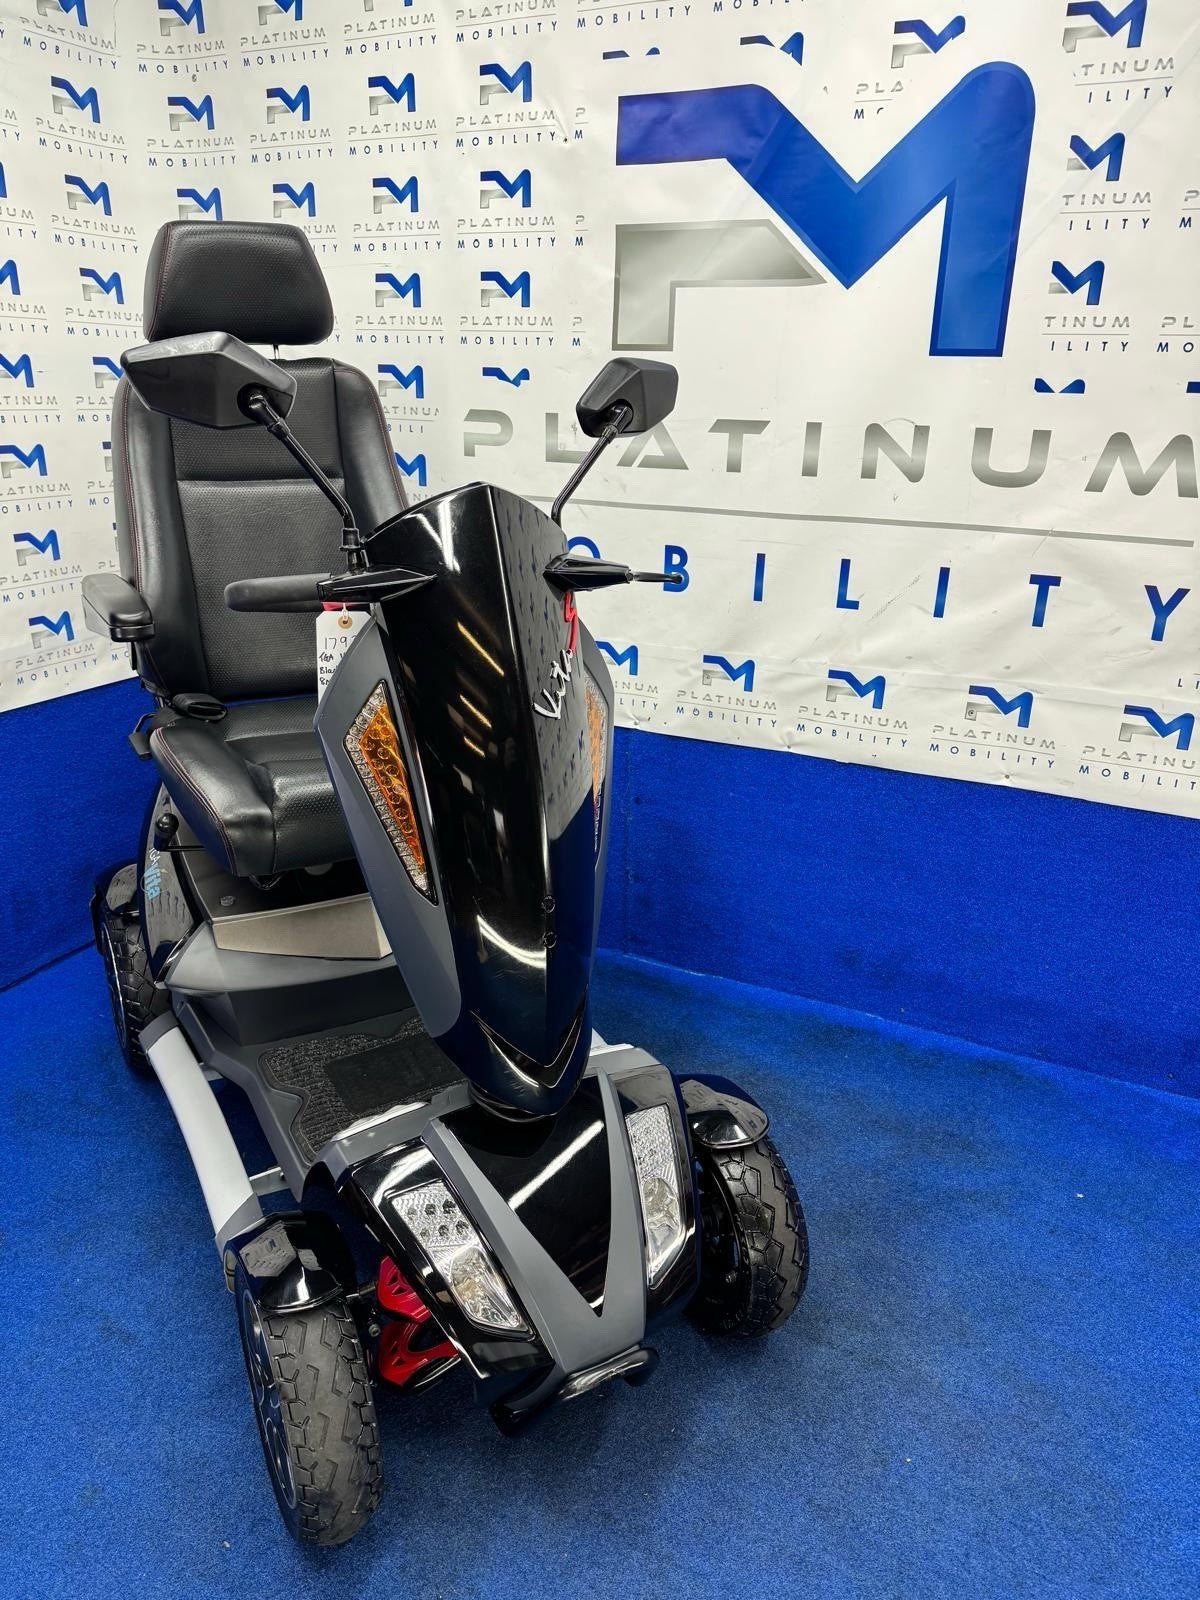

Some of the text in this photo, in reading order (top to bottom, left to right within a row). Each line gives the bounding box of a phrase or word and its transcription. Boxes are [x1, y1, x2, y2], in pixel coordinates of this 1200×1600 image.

[344, 13, 436, 34] PLATINUM
[577, 5, 691, 28] MOBILITY
[20, 16, 114, 49] PLATINUM
[240, 28, 326, 46] PLATINUM
[456, 21, 558, 43] MOBILITY
[23, 36, 117, 69] MOBILITY
[137, 40, 225, 55] PLATINUM
[345, 35, 437, 55] MOBILITY
[243, 49, 329, 67] MOBILITY
[138, 60, 229, 73] MOBILITY
[1073, 57, 1174, 77] TINUM
[456, 110, 555, 126] PLATINUM
[36, 117, 125, 145] PLATINUM
[349, 119, 437, 135] PLATINUM
[147, 136, 235, 148] PLATINUM
[250, 128, 331, 144] PLATINUM
[456, 132, 556, 148] MOBILITY
[39, 137, 128, 164] MOBILITY
[251, 148, 334, 164] MOBILITY
[349, 140, 438, 156] MOBILITY
[149, 155, 236, 168] MOBILITY
[51, 215, 137, 235] PLATINUM
[353, 220, 440, 233] PLATINUM
[457, 217, 555, 228] PLATINUM
[54, 234, 138, 254] MOBILITY
[354, 241, 441, 252] MOBILITY
[457, 237, 555, 249] MOBILITY
[0, 302, 46, 314] INUM
[355, 315, 443, 326] PLATINUM
[460, 316, 553, 326] PLATINUM
[67, 327, 138, 338] MOBILIT
[356, 334, 444, 344] MOBILITY
[460, 336, 554, 346] MOBILITY
[0, 395, 58, 405] TINUM
[0, 414, 61, 423] BILITY
[462, 408, 1198, 498] PLATINUM
[0, 482, 70, 496] ATINUM
[2, 500, 73, 514] OBILITY
[3, 583, 74, 602] MOBILIT
[324, 634, 358, 649] 179
[16, 642, 94, 669] PLATINUM
[17, 657, 97, 685] MOBILITY
[615, 681, 658, 694] INUM
[620, 697, 658, 710] LITY
[677, 690, 777, 710] PLATINUM
[676, 705, 777, 727] MOBILITY
[799, 705, 908, 729] PLATINUM
[797, 723, 908, 747] MOBILITY
[932, 725, 1055, 749] PLATINUM
[929, 743, 1054, 768] MOBILITY
[1082, 745, 1196, 769] PLATINU
[1079, 765, 1197, 790] MOBILIT
